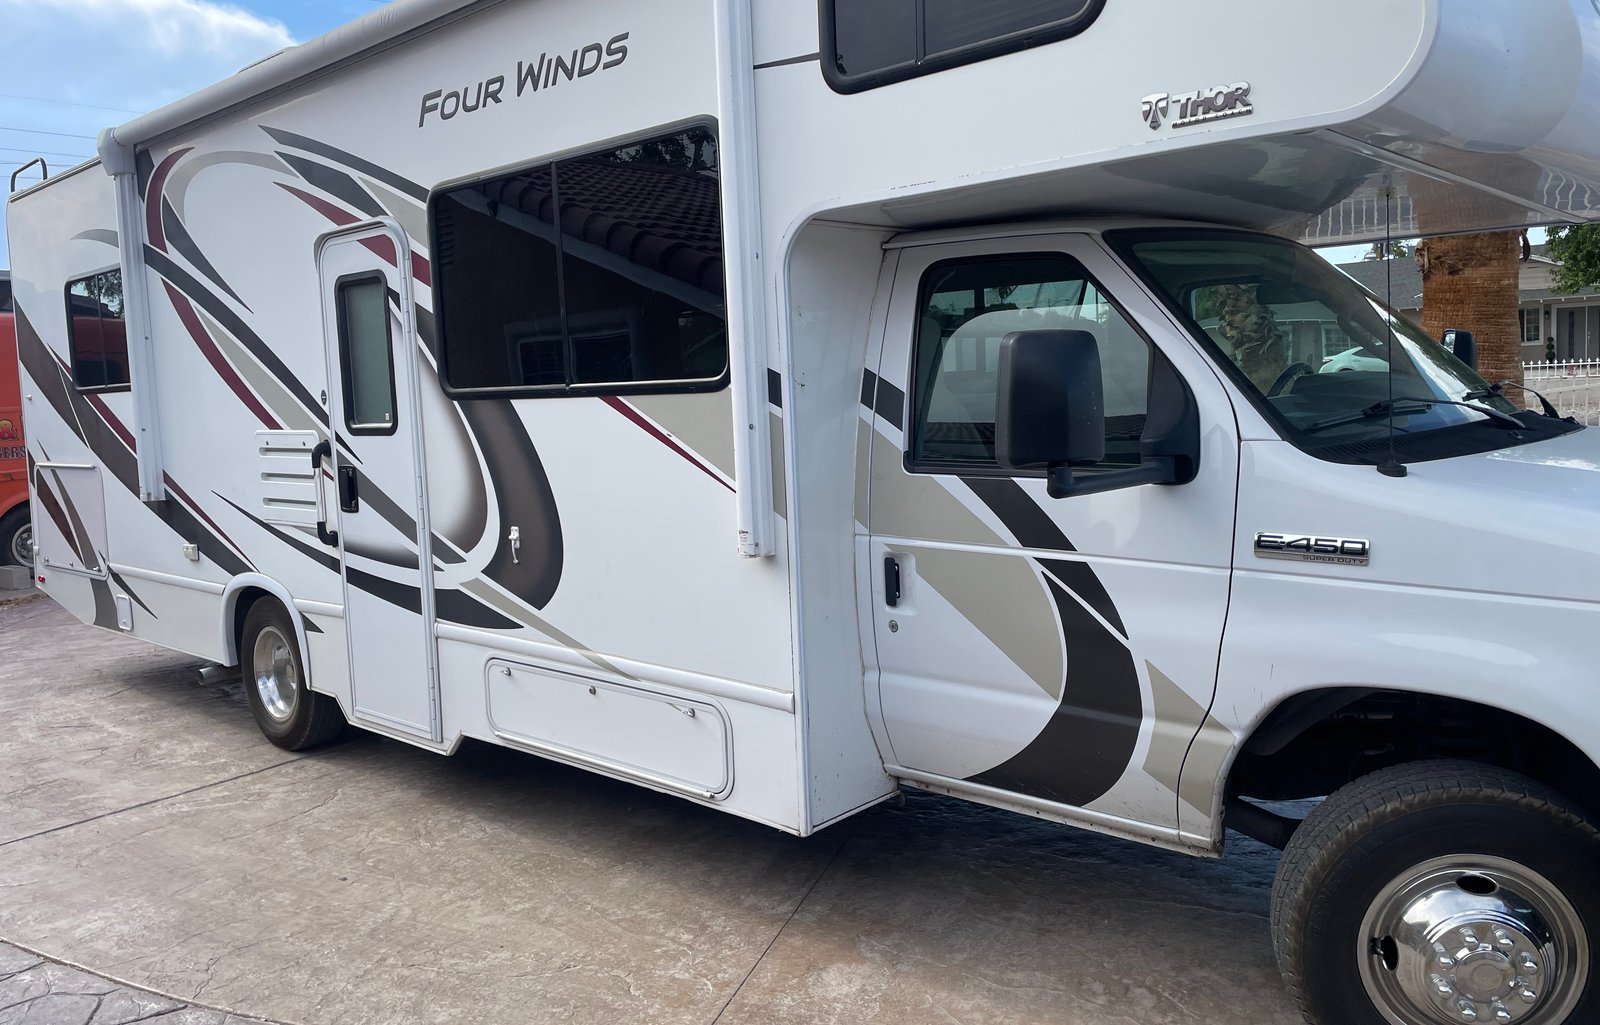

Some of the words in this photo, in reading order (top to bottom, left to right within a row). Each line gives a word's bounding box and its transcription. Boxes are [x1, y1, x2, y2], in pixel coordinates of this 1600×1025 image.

[418, 75, 505, 128] FOUR
[516, 31, 630, 97] WINDS
[1171, 81, 1253, 120] THOR
[1302, 555, 1335, 563] SUPER
[1337, 557, 1365, 565] DUTY
